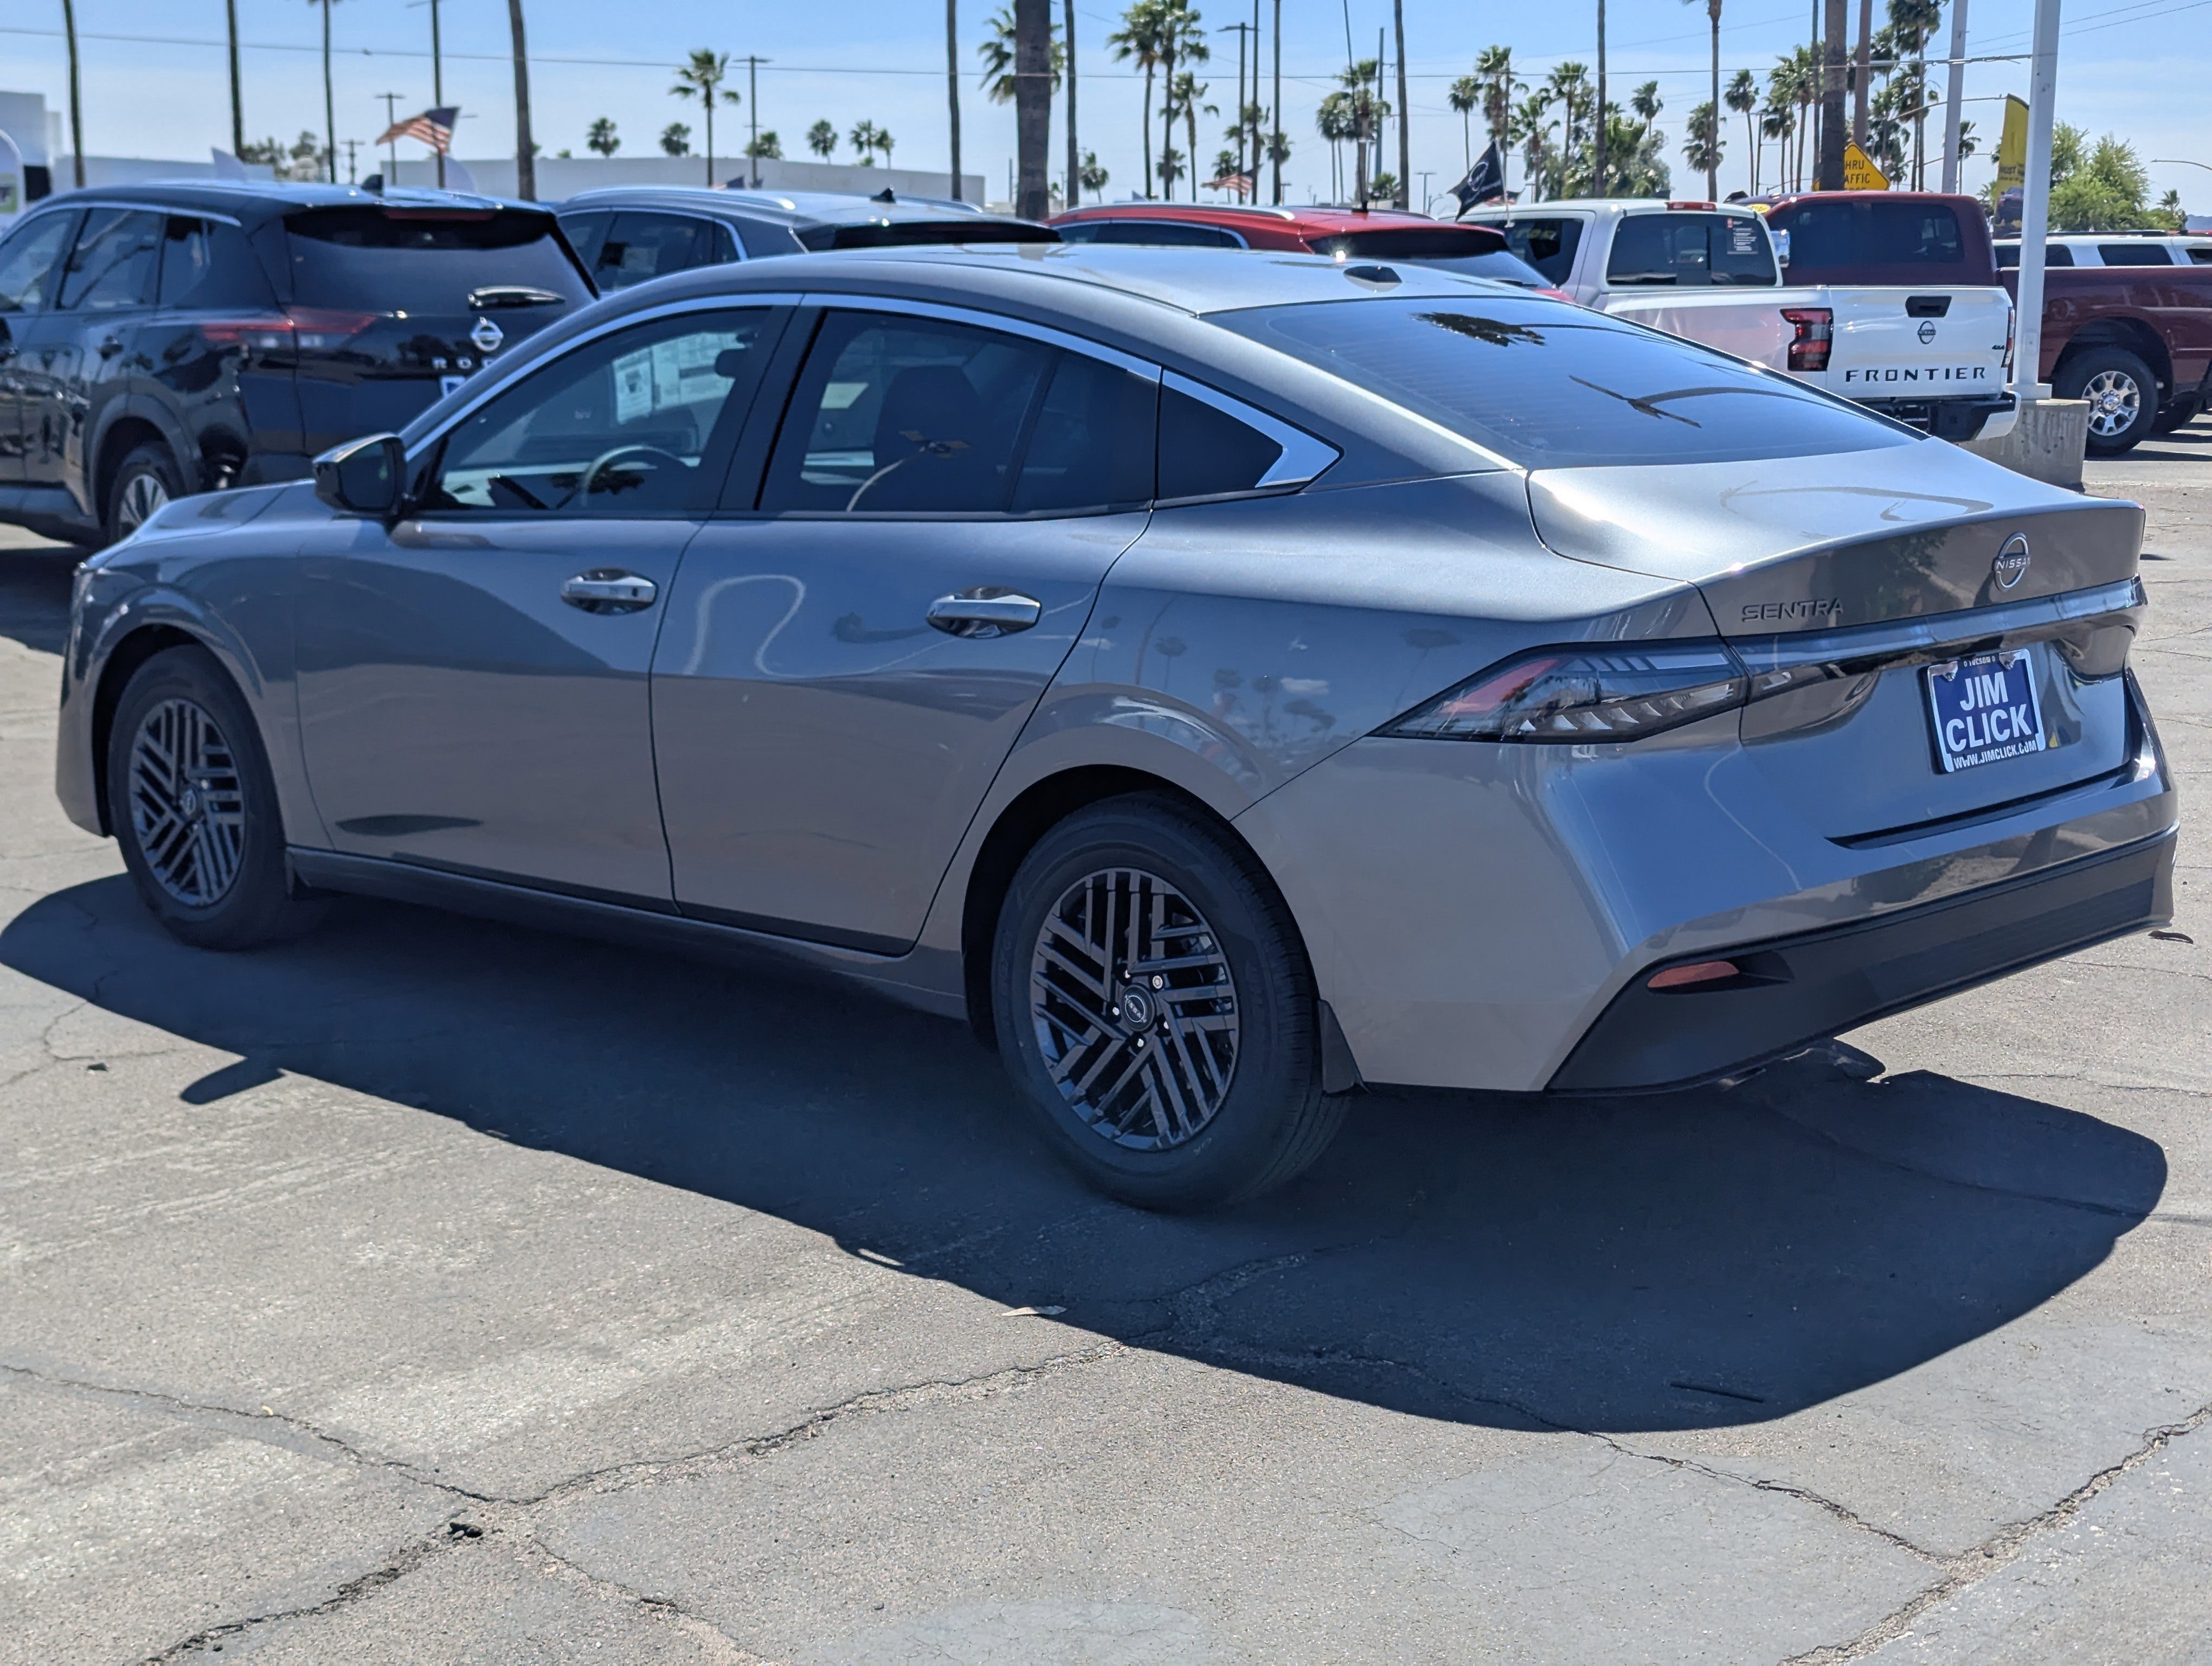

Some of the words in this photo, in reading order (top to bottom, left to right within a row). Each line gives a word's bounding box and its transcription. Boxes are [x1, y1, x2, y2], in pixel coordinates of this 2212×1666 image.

[1846, 159, 1864, 170] HRU
[1846, 367, 1986, 383] FRONTIER
[1741, 597, 1843, 623] SENTRA
[1960, 671, 2009, 712] JIM
[1946, 703, 2032, 752] CLICK
[1953, 739, 2037, 769] WWW.JIMCLICK.COM
